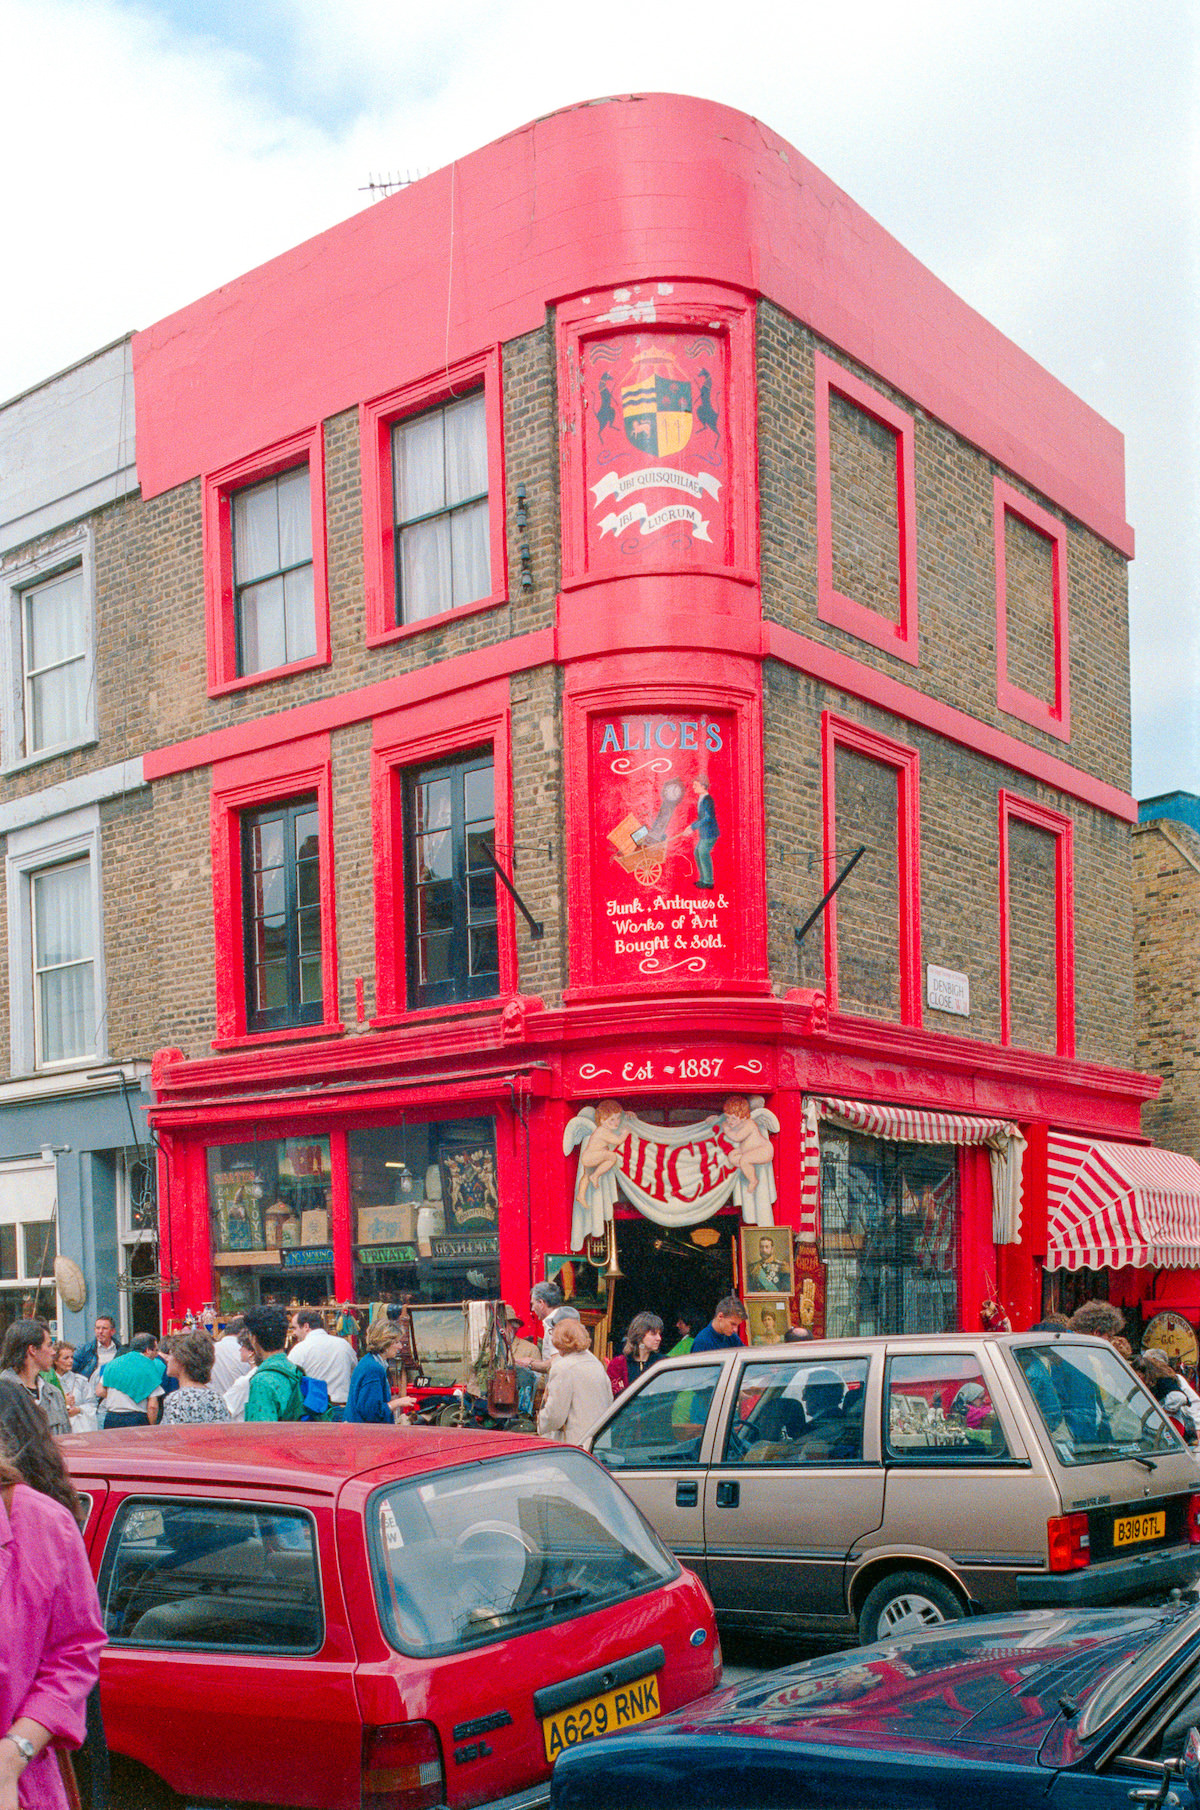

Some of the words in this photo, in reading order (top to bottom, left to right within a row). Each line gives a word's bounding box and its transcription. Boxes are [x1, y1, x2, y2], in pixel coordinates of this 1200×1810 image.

[618, 476, 635, 493] UBI
[637, 471, 700, 494] QUISQUILIAE
[619, 512, 633, 528] IBI
[648, 509, 696, 530] LUCRUM
[599, 721, 723, 753] ALICE'S
[653, 894, 715, 916] Antiques
[717, 893, 729, 910] &
[612, 917, 664, 934] Works
[671, 915, 685, 930] of
[691, 912, 718, 930] Art
[614, 934, 669, 957] Bought
[674, 934, 688, 950] &
[933, 978, 965, 999] DENBIGH
[621, 1061, 654, 1081] Est
[678, 1058, 724, 1079] 1887
[251, 1198, 262, 1243] TOYS
[363, 1248, 410, 1262] PRIVATE
[1118, 1520, 1141, 1542] B319
[1142, 1517, 1161, 1537] GTL
[550, 1702, 608, 1755] A629
[615, 1680, 659, 1726] RNK
